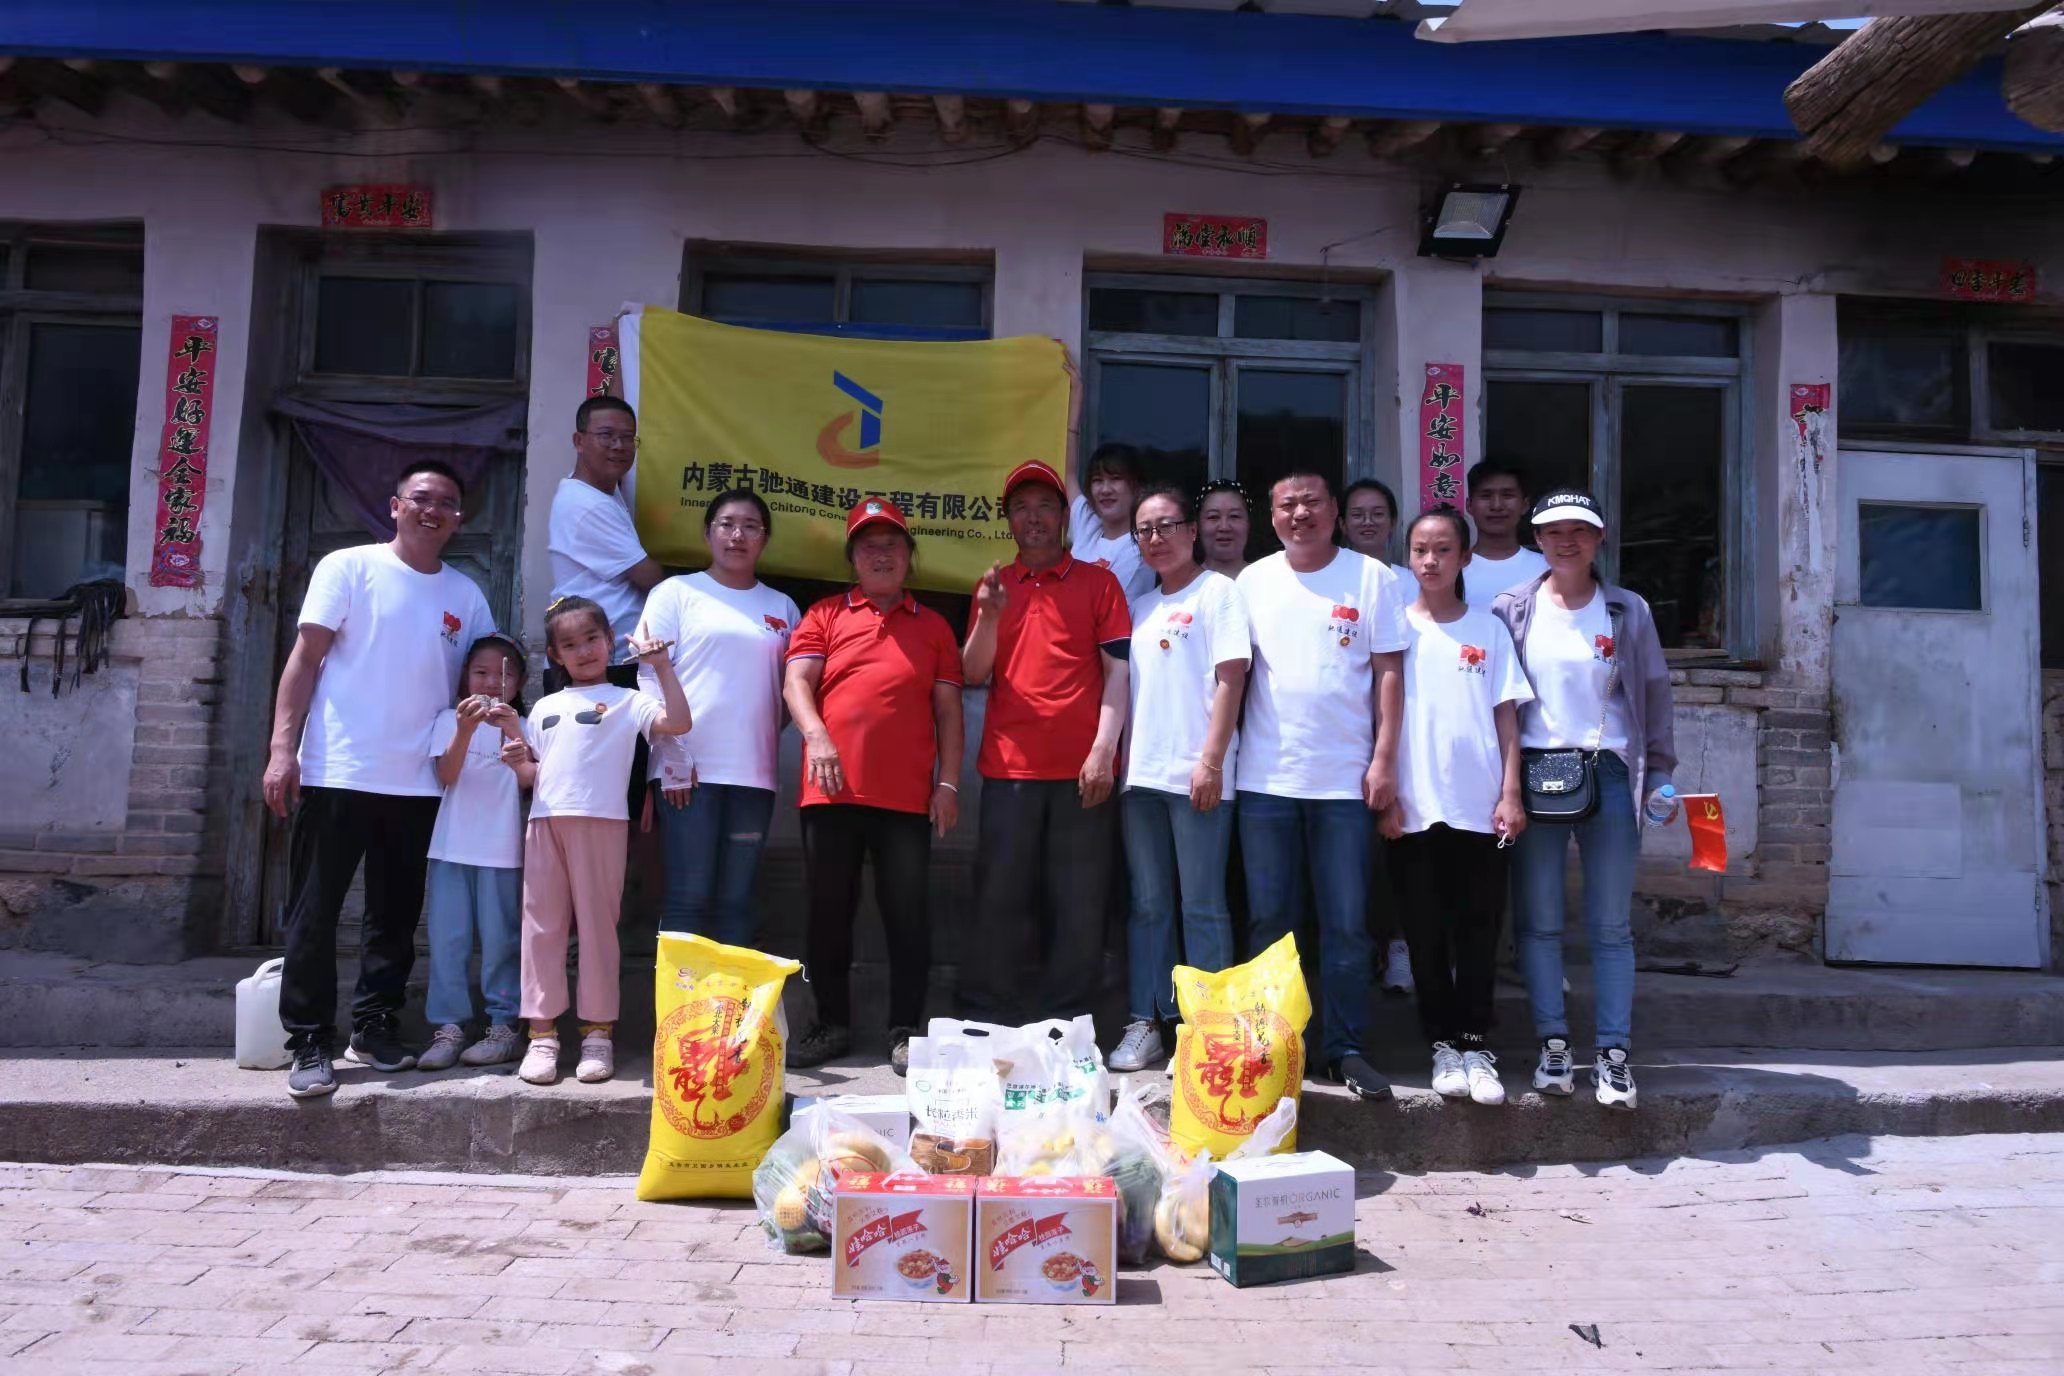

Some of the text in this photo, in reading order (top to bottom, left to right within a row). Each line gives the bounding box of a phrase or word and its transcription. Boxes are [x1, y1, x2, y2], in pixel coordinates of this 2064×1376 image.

[1425, 383, 1462, 499] 平安如意
[682, 461, 1008, 523] 内蒙古驰通建设程有限公
[770, 501, 816, 516] Chitong
[909, 525, 965, 540] gineering
[848, 1223, 887, 1254] 娃哈哈
[992, 1227, 1030, 1257] 娃哈哈
